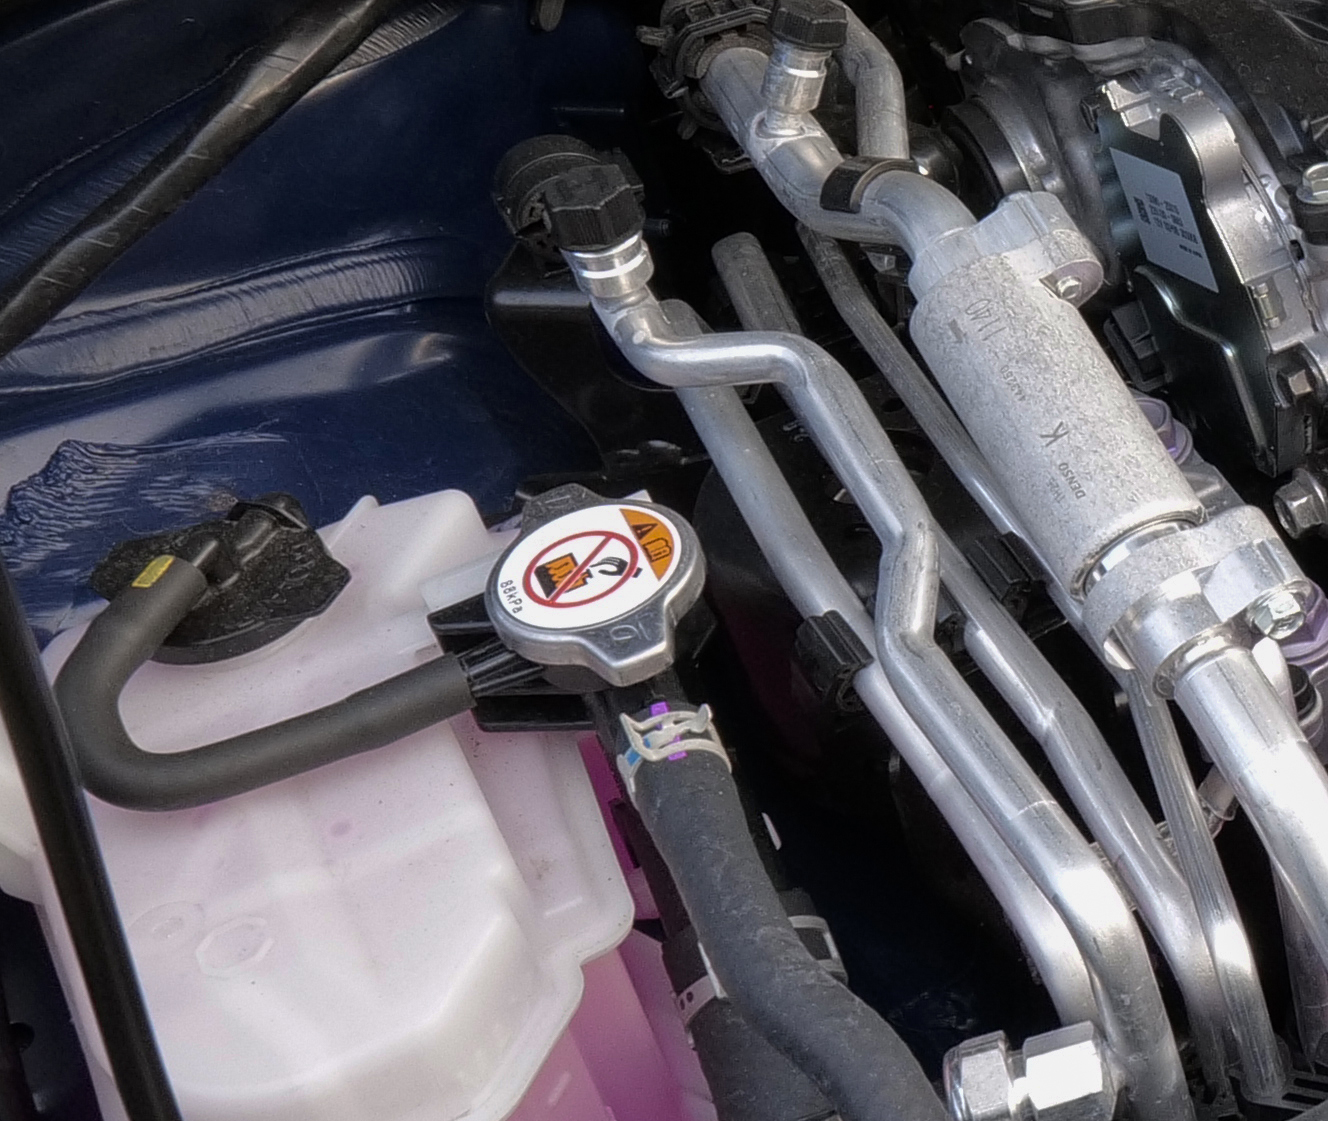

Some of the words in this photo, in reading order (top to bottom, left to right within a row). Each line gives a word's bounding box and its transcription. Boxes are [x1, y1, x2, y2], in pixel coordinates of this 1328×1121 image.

[1039, 421, 1069, 447] K
[1058, 462, 1086, 500] DENSO
[500, 579, 523, 614] 88kPa
